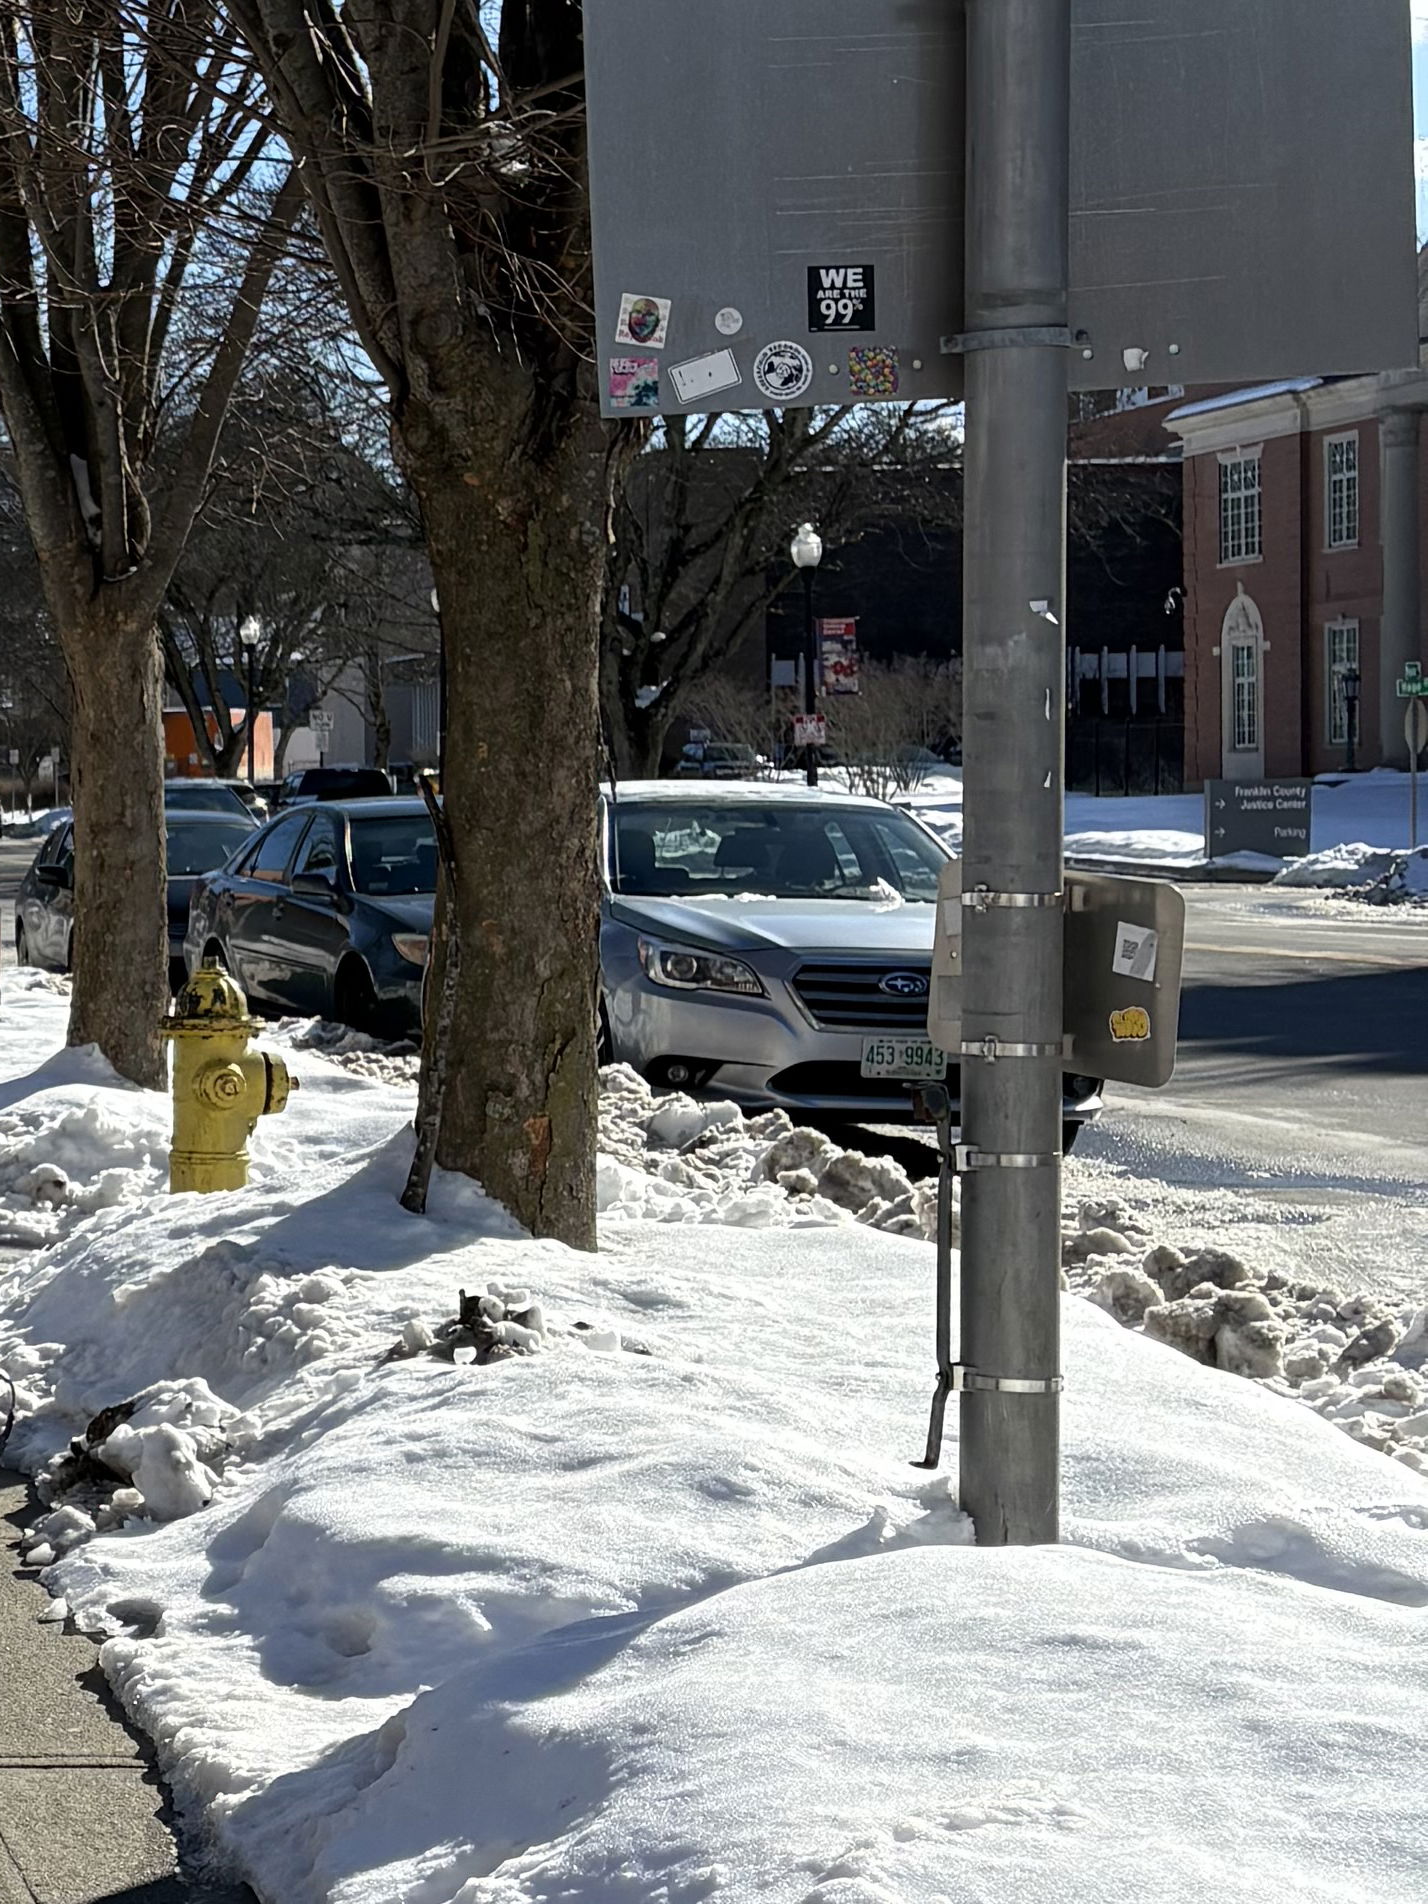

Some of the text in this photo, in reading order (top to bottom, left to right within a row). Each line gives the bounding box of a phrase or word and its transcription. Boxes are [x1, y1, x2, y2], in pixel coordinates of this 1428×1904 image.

[819, 267, 864, 289] WE
[816, 288, 867, 299] ARE THE
[820, 298, 864, 325] 99%
[1234, 785, 1306, 798] Franklin County
[1240, 799, 1306, 810] Justice Center
[1274, 826, 1306, 839] Parking
[865, 1044, 944, 1066] 453 9943
